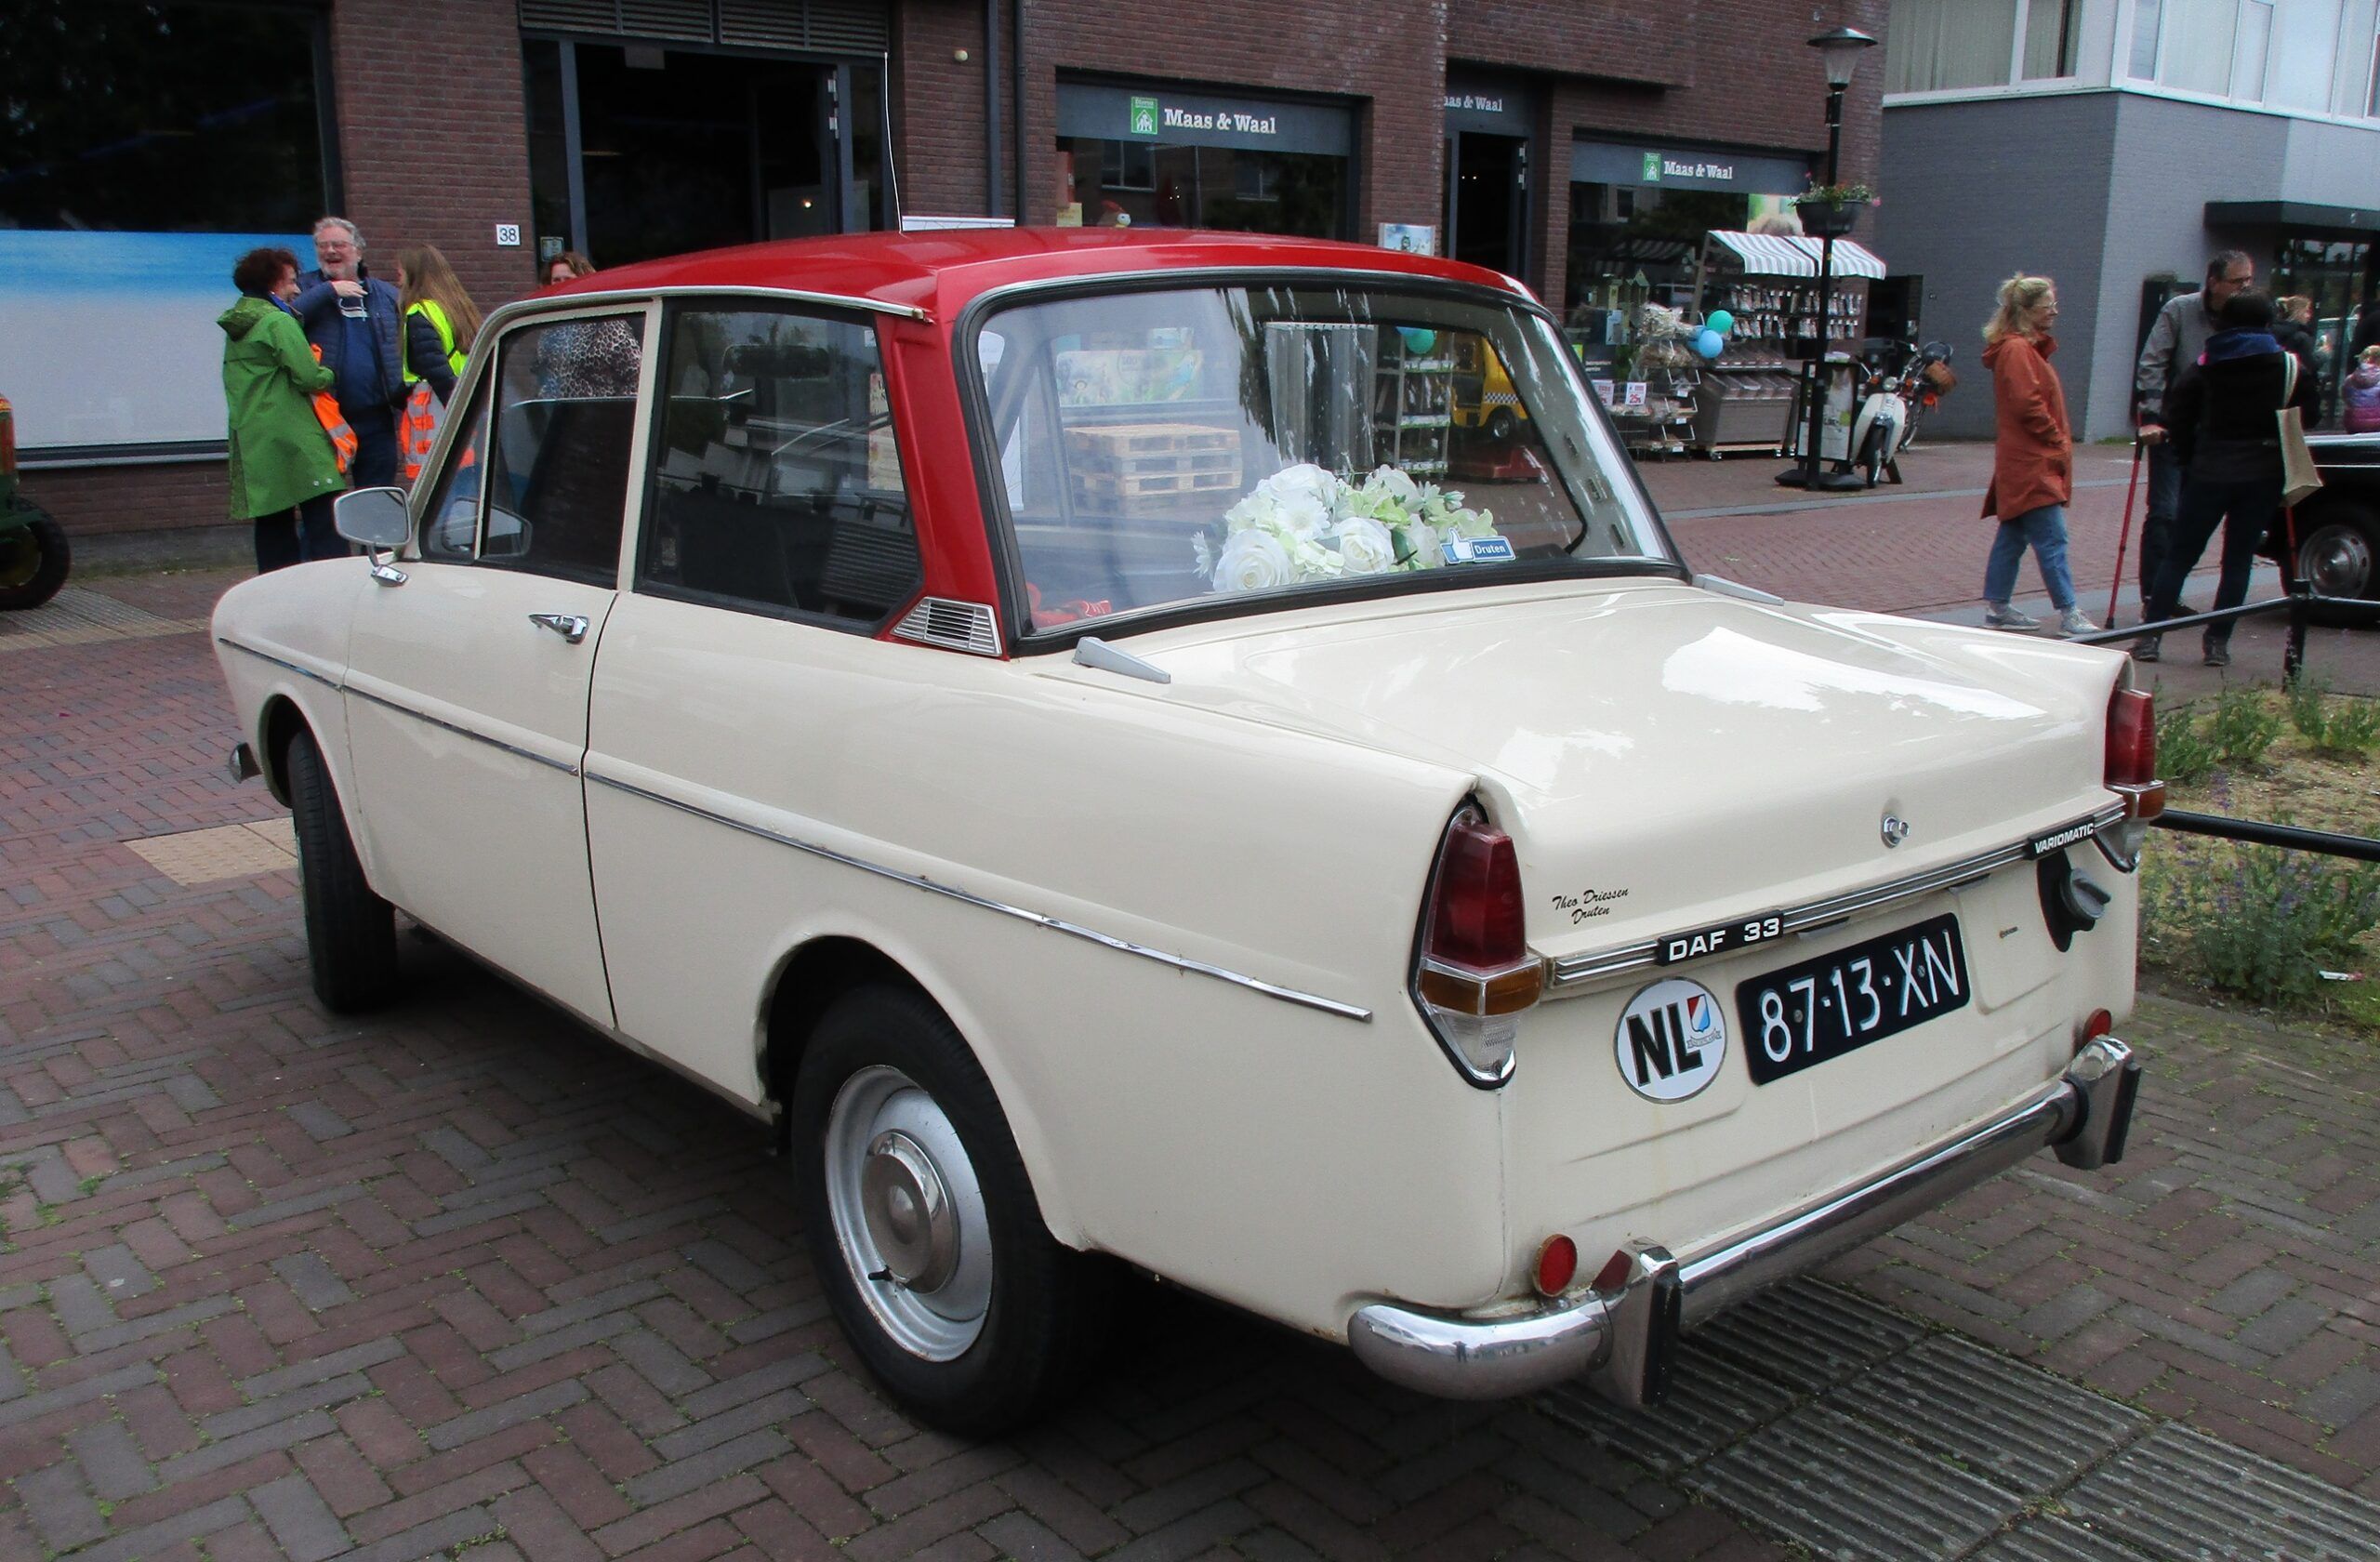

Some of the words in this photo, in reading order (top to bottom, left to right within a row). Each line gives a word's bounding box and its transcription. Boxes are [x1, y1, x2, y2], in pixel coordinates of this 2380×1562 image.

[1443, 96, 1461, 108] aas
[1463, 95, 1474, 109] &
[1474, 97, 1502, 112] Waal
[1164, 109, 1212, 129] Maas
[1216, 113, 1232, 131] &
[1234, 114, 1276, 134] Waal
[1664, 161, 1694, 177] Maas
[1695, 164, 1705, 178] &
[1706, 165, 1732, 179] Waal
[499, 228, 517, 242] 38
[1474, 544, 1506, 555] Druten
[2034, 823, 2094, 854] VARIOMATIC
[1552, 895, 1579, 910] Theo
[1583, 887, 1629, 905] Driessen
[1571, 905, 1610, 924] Druten
[1669, 930, 1726, 961] DAF
[1744, 918, 1780, 942] 33
[1626, 1004, 1703, 1087] NL
